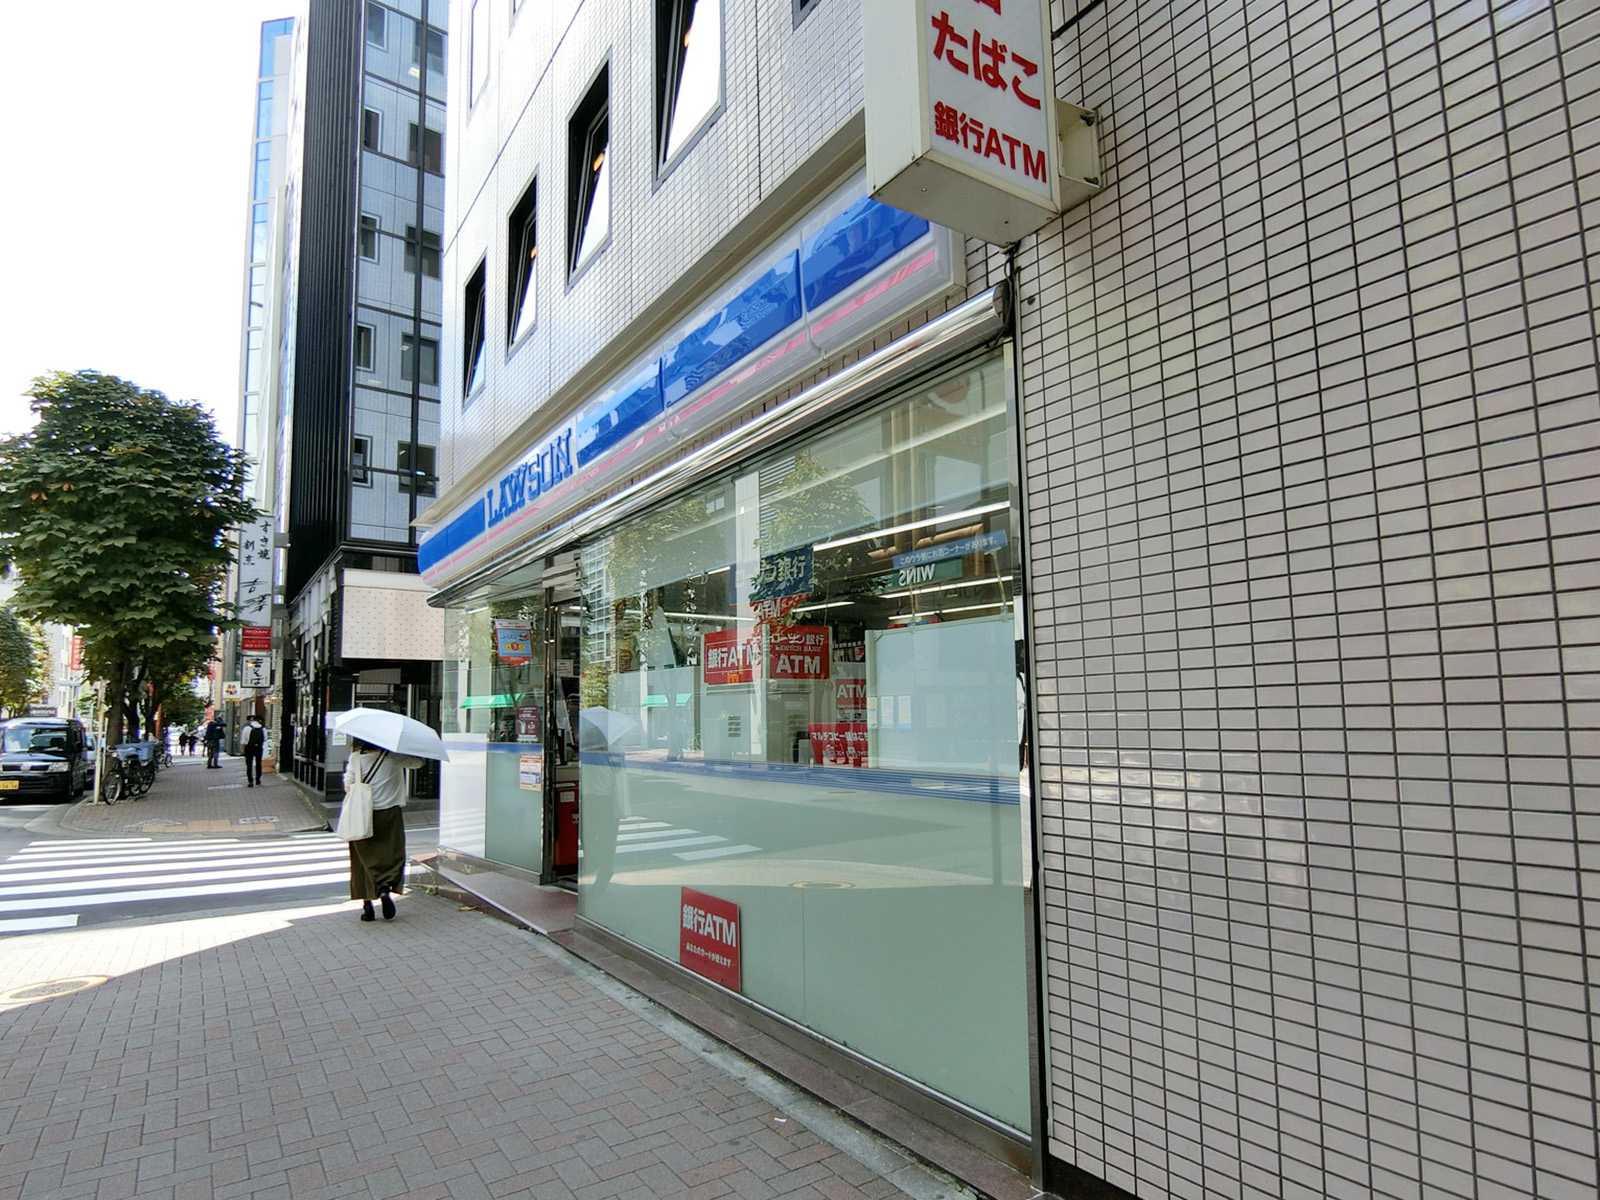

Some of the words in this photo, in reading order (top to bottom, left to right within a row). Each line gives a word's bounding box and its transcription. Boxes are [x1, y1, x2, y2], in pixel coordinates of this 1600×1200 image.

[931, 11, 1041, 110] たばこ
[933, 101, 1047, 183] 銀行ATM
[487, 428, 573, 528] LAWSON
[776, 653, 820, 674] ATM
[682, 904, 736, 947] 銀行ATM
